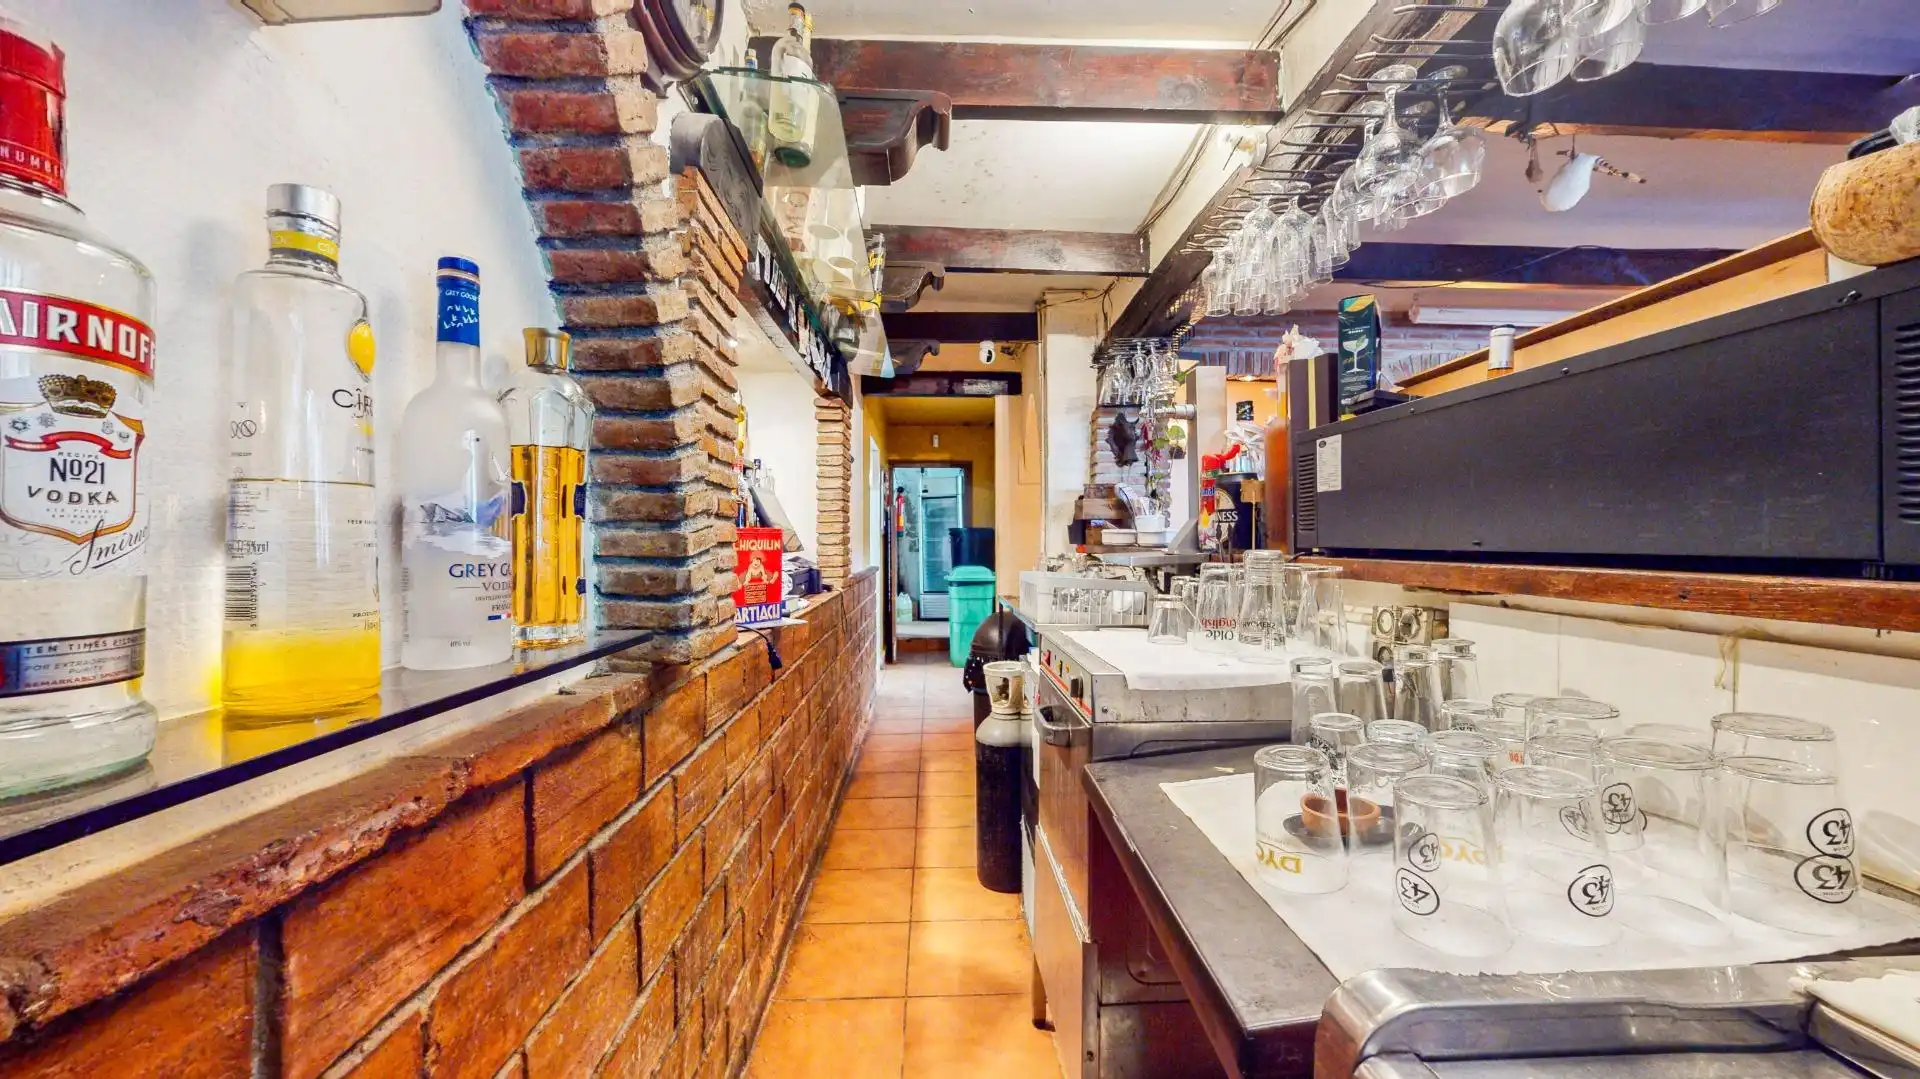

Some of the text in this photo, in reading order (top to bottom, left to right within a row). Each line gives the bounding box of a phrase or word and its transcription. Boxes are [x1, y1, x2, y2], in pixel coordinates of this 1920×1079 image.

[27, 485, 119, 505] VODKA
[448, 563, 498, 578] GREY
[481, 581, 513, 592] VOD
[1205, 629, 1235, 641] Olde
[25, 645, 58, 655] TEN
[69, 640, 108, 651] TIMES
[1822, 819, 1851, 845] 43
[1419, 843, 1439, 863] 43
[1811, 865, 1851, 889] 43
[1400, 876, 1431, 904] 43
[1581, 875, 1611, 905] 43
